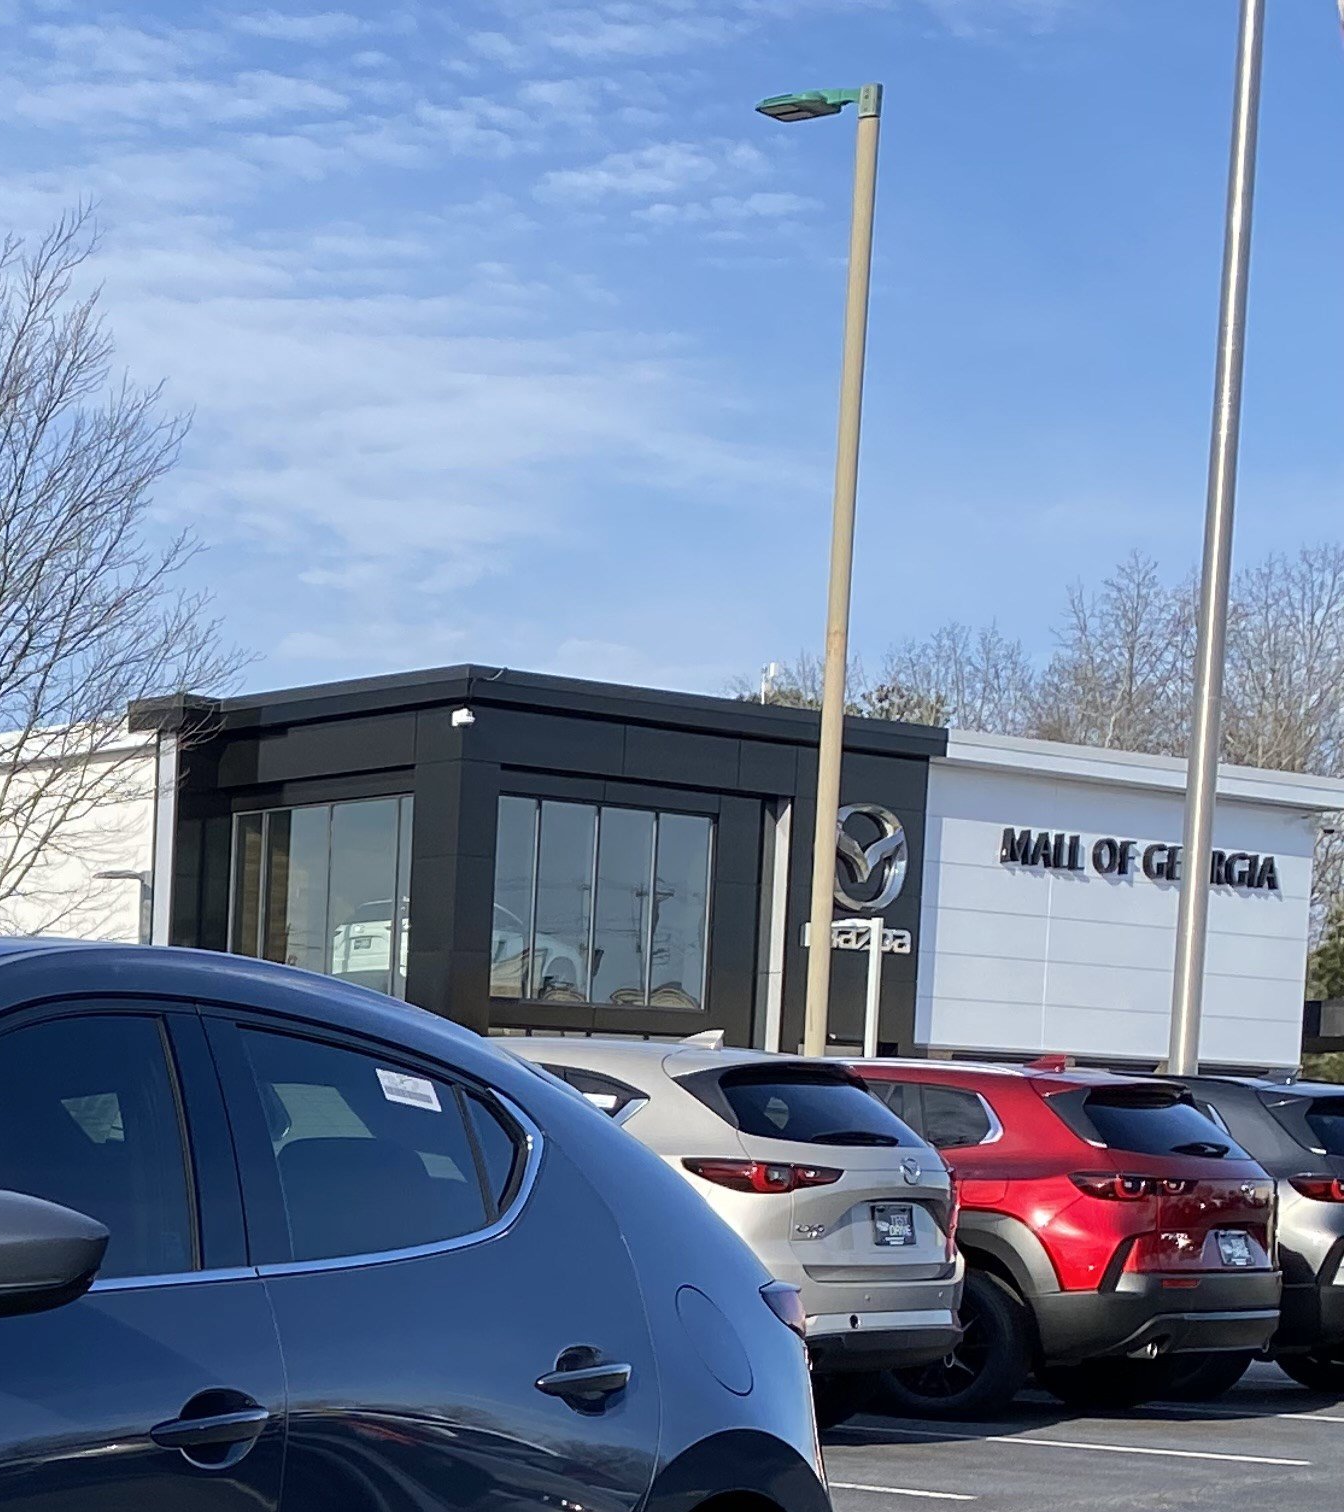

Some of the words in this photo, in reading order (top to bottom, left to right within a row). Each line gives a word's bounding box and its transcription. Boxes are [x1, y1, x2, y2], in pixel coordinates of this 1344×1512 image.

[1000, 827, 1086, 871] MALL
[1092, 837, 1138, 876] OF
[1143, 843, 1279, 891] GERGIA
